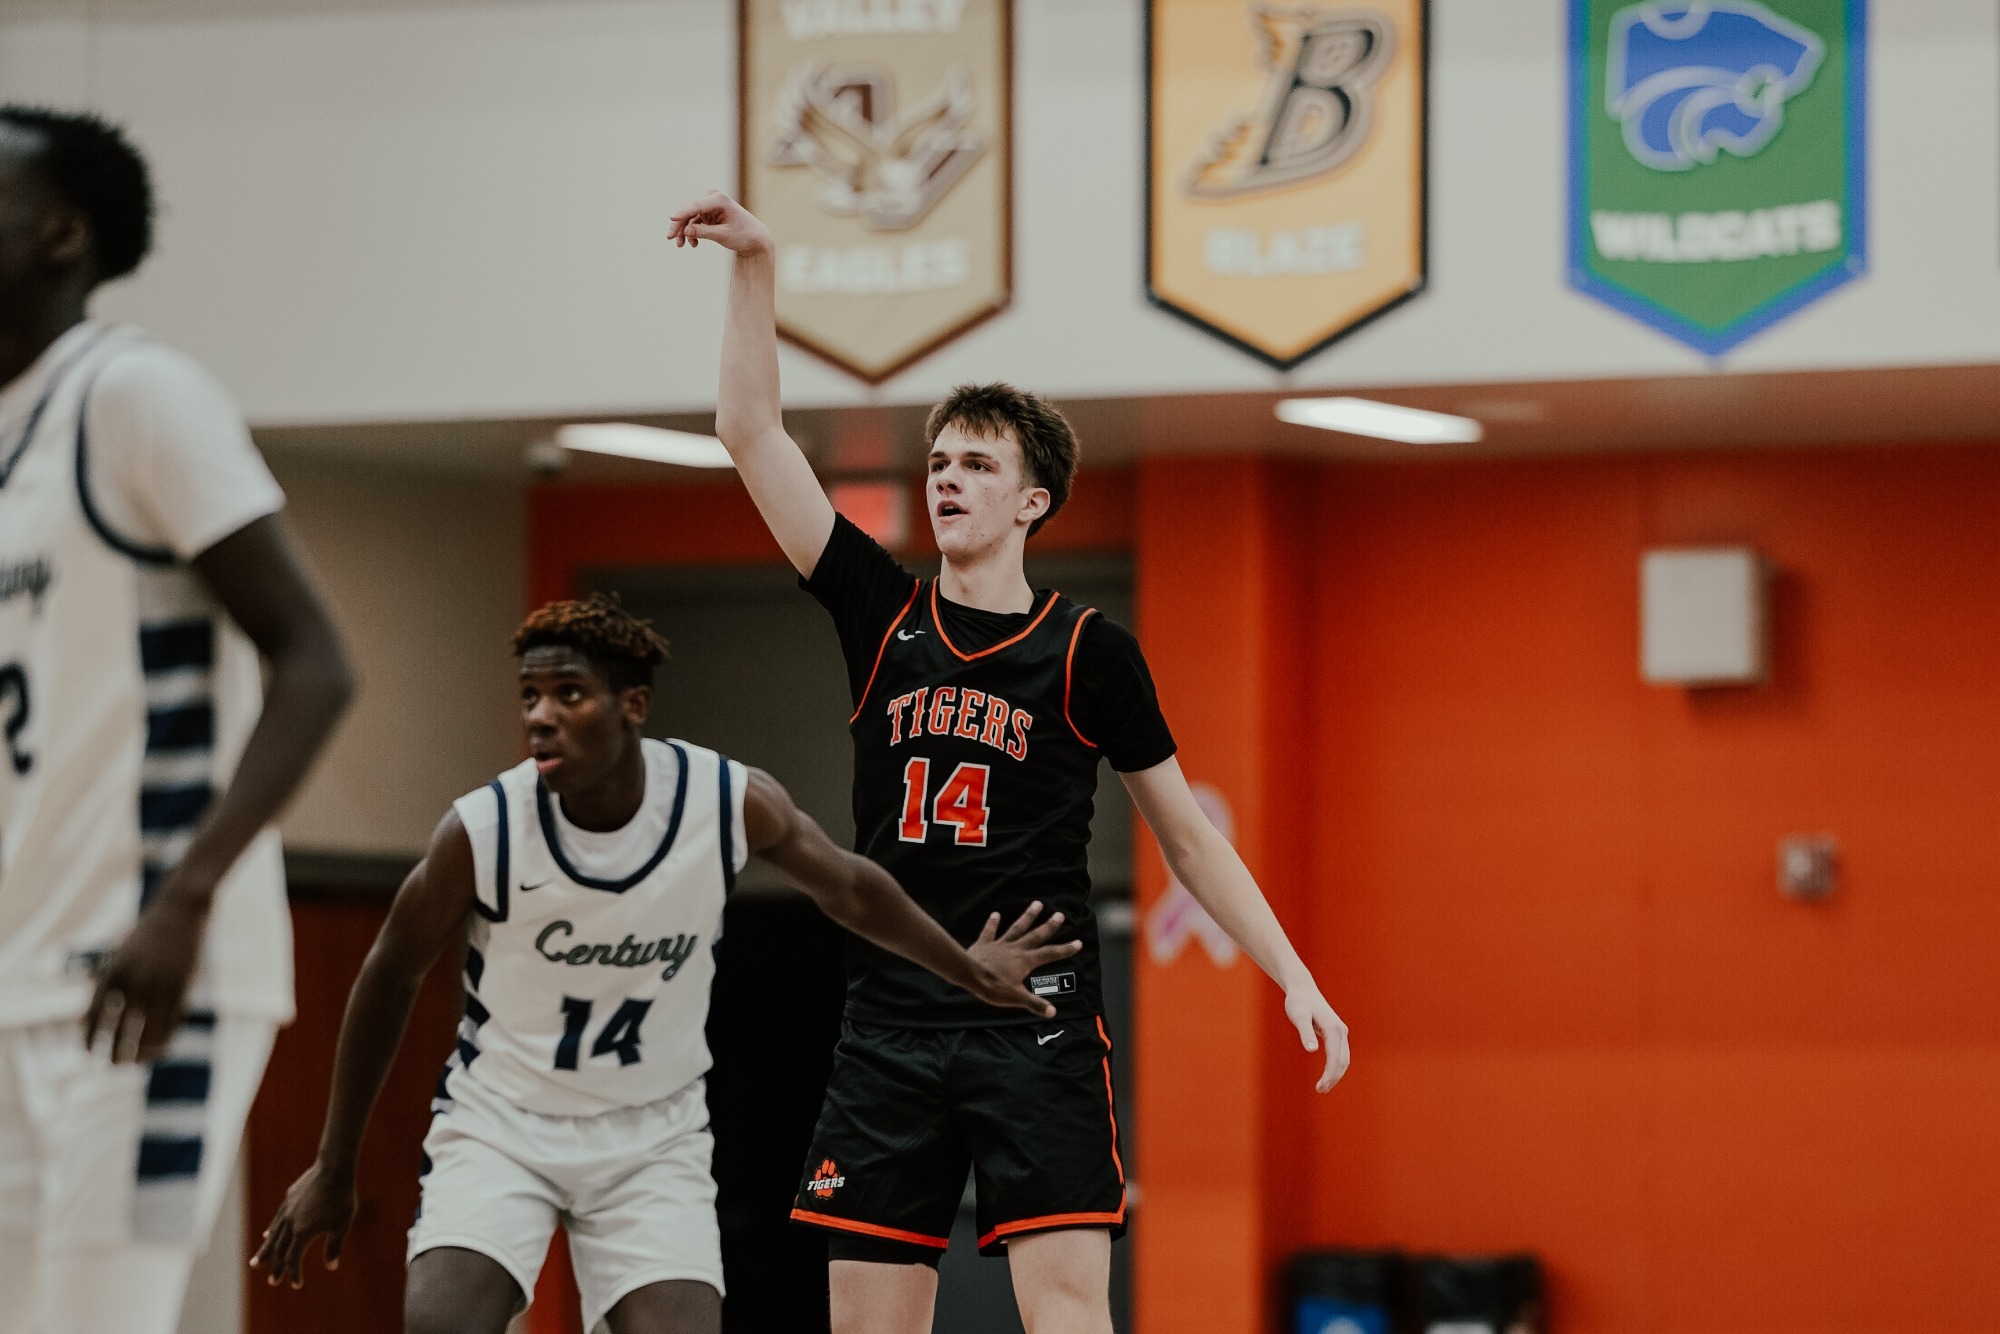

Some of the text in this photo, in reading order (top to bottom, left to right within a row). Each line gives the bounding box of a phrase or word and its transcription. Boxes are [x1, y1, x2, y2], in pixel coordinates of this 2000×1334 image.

[1204, 221, 1366, 277] BLAZE
[1590, 200, 1842, 262] WILDCATS
[782, 239, 969, 294] EAGLES
[887, 686, 1033, 762] TIGERS
[898, 756, 991, 847] 14
[535, 920, 698, 981] Century
[1063, 978, 1071, 988] L
[553, 994, 655, 1071] 14
[807, 1176, 846, 1191] TIGERS
